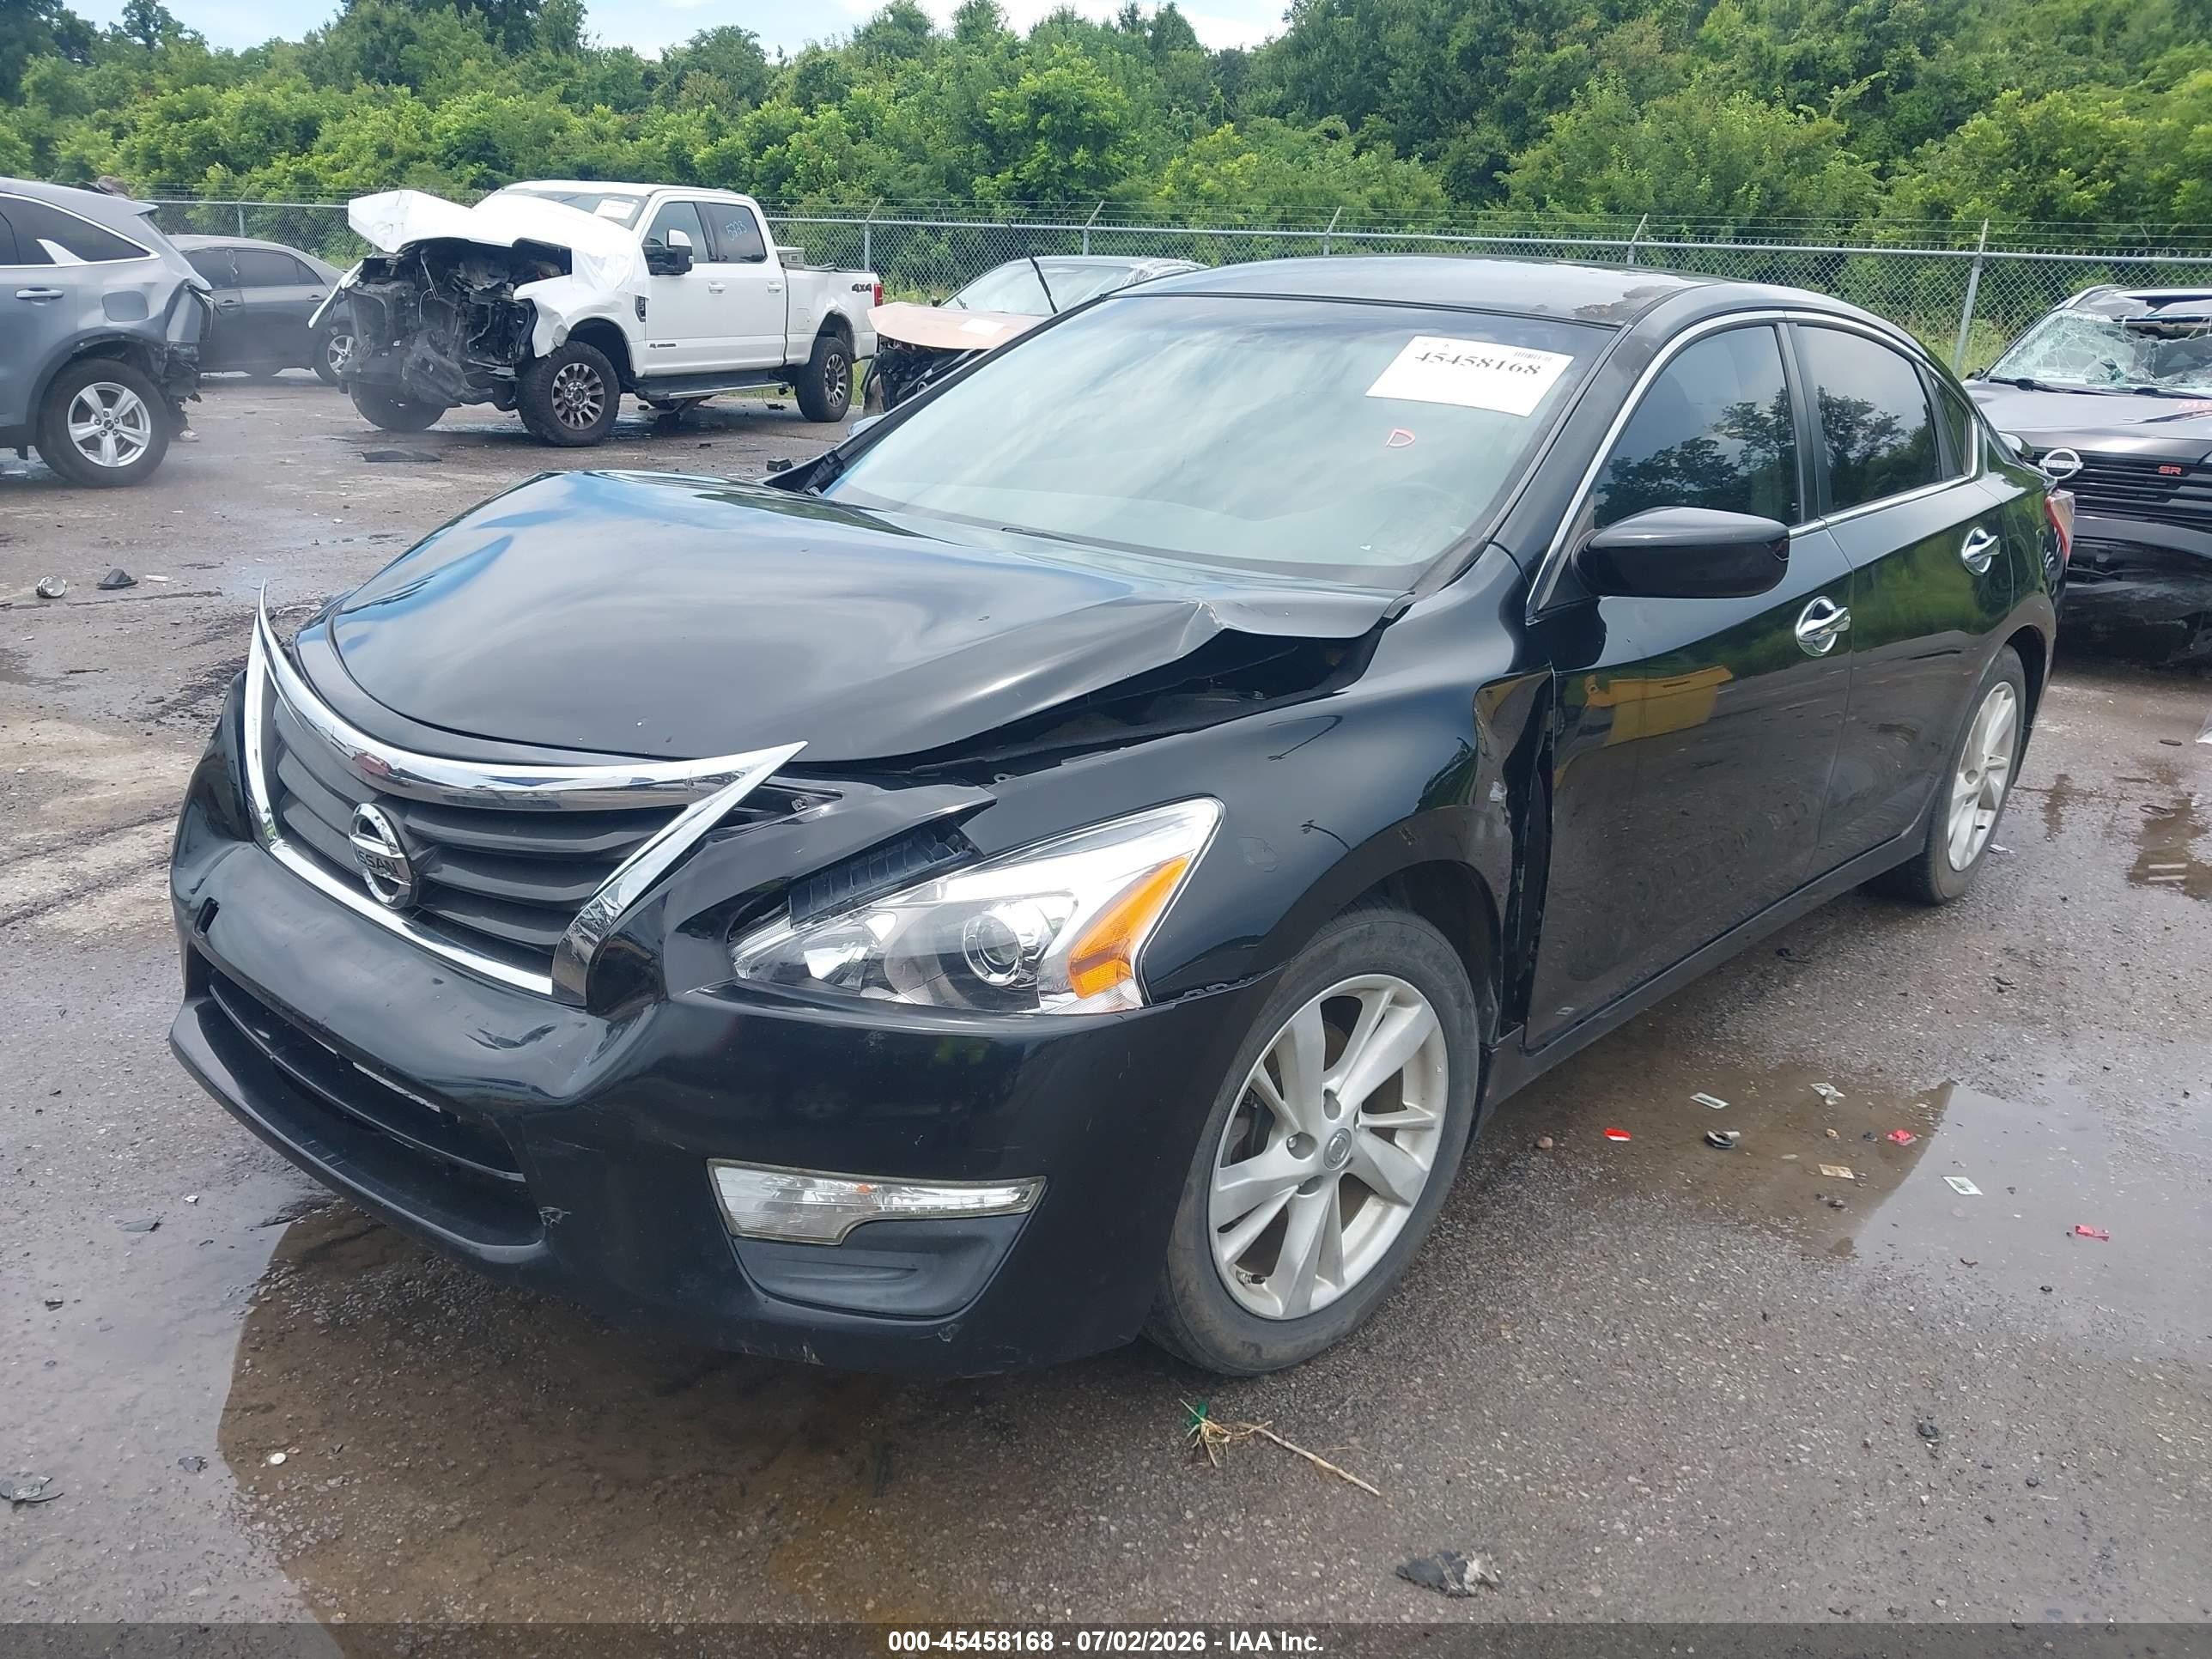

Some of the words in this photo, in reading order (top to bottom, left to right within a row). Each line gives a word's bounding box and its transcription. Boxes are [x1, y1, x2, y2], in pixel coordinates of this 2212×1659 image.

[1414, 350, 1543, 375] 45458168
[2039, 459, 2083, 470] NISSAN
[2158, 465, 2182, 476] SR
